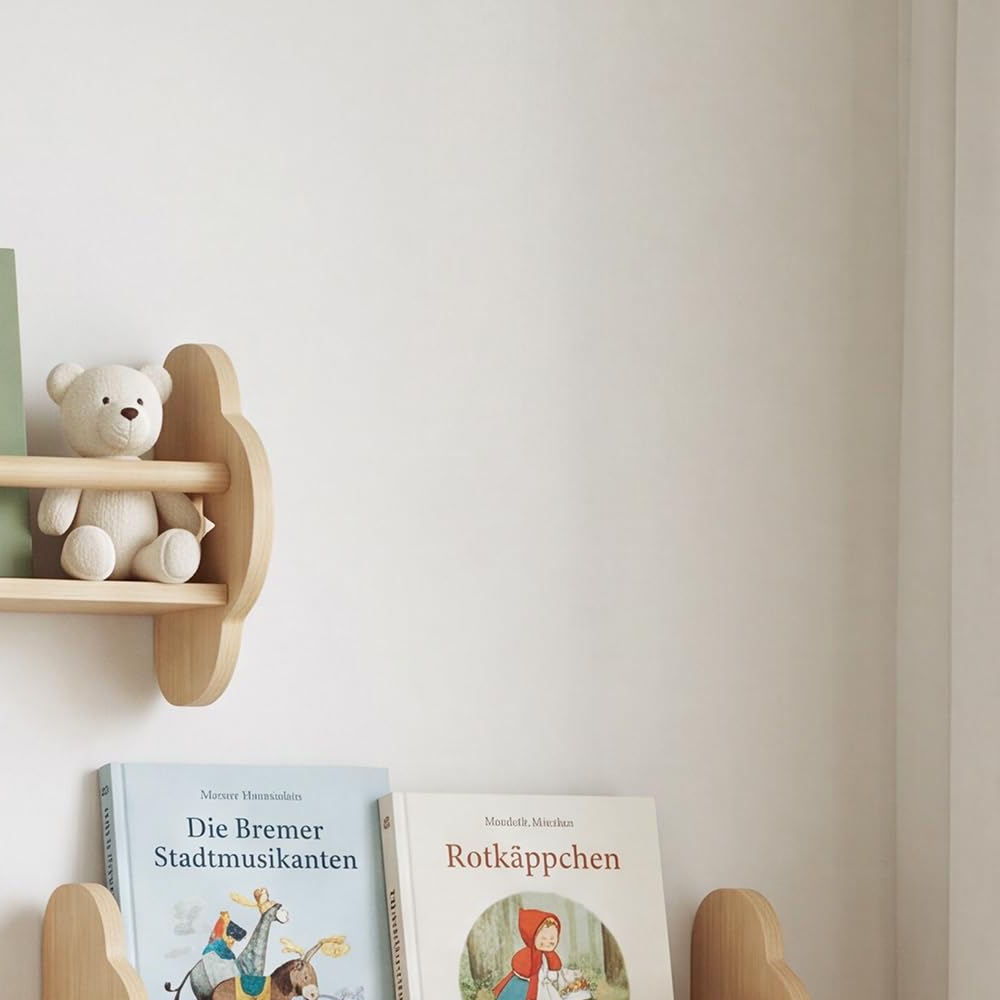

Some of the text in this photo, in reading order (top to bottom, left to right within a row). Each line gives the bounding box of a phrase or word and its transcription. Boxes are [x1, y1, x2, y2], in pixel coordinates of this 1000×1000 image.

[186, 816, 324, 840] Die Bremer
[154, 846, 358, 870] Stadtmusikanten
[445, 842, 622, 878] Rotkäppchen
